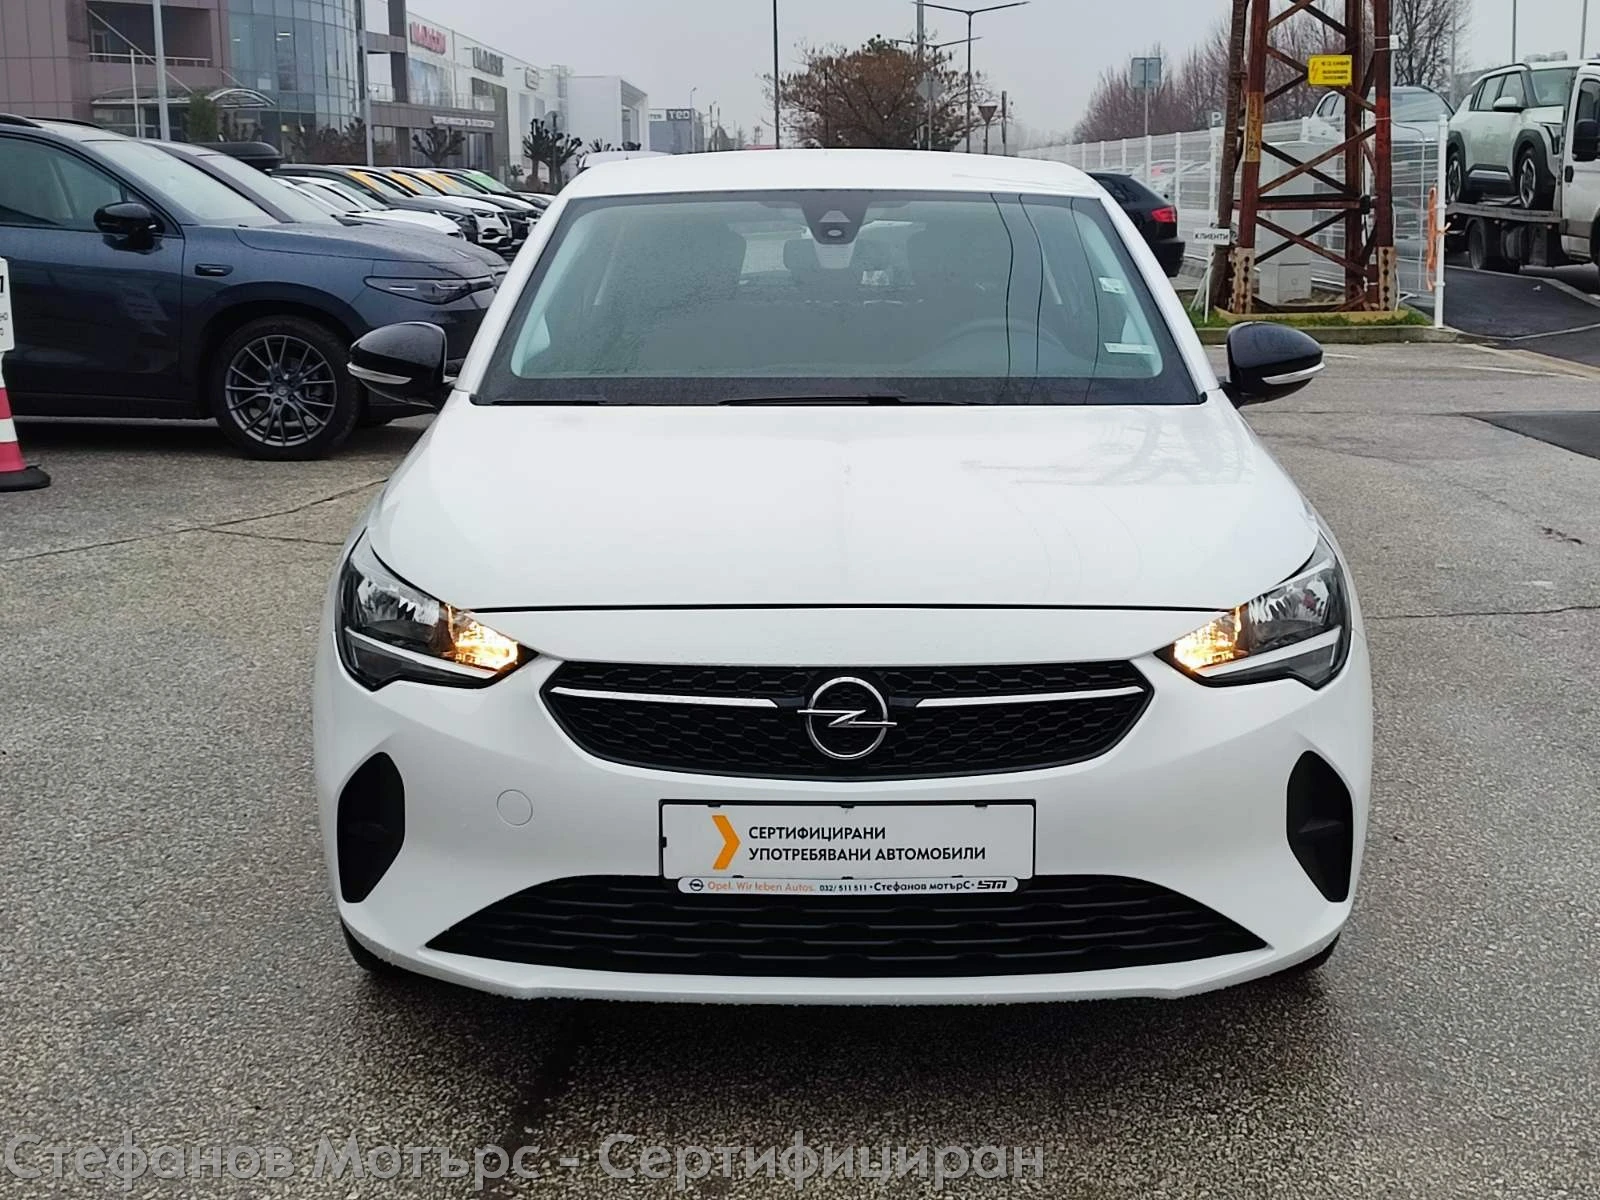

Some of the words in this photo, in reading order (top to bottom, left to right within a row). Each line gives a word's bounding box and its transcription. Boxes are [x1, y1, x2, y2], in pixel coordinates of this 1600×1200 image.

[1194, 232, 1229, 240] КЛИЕНТИ
[748, 826, 886, 842] СЕРТИФИЦИРАНИ
[748, 848, 871, 861] УПОТРЕБЯВАНИ
[875, 847, 986, 860] АВТОМОБИЛИ
[736, 881, 752, 890] Wir
[755, 880, 782, 892] leben
[838, 884, 851, 892] 511
[854, 884, 867, 892] 511
